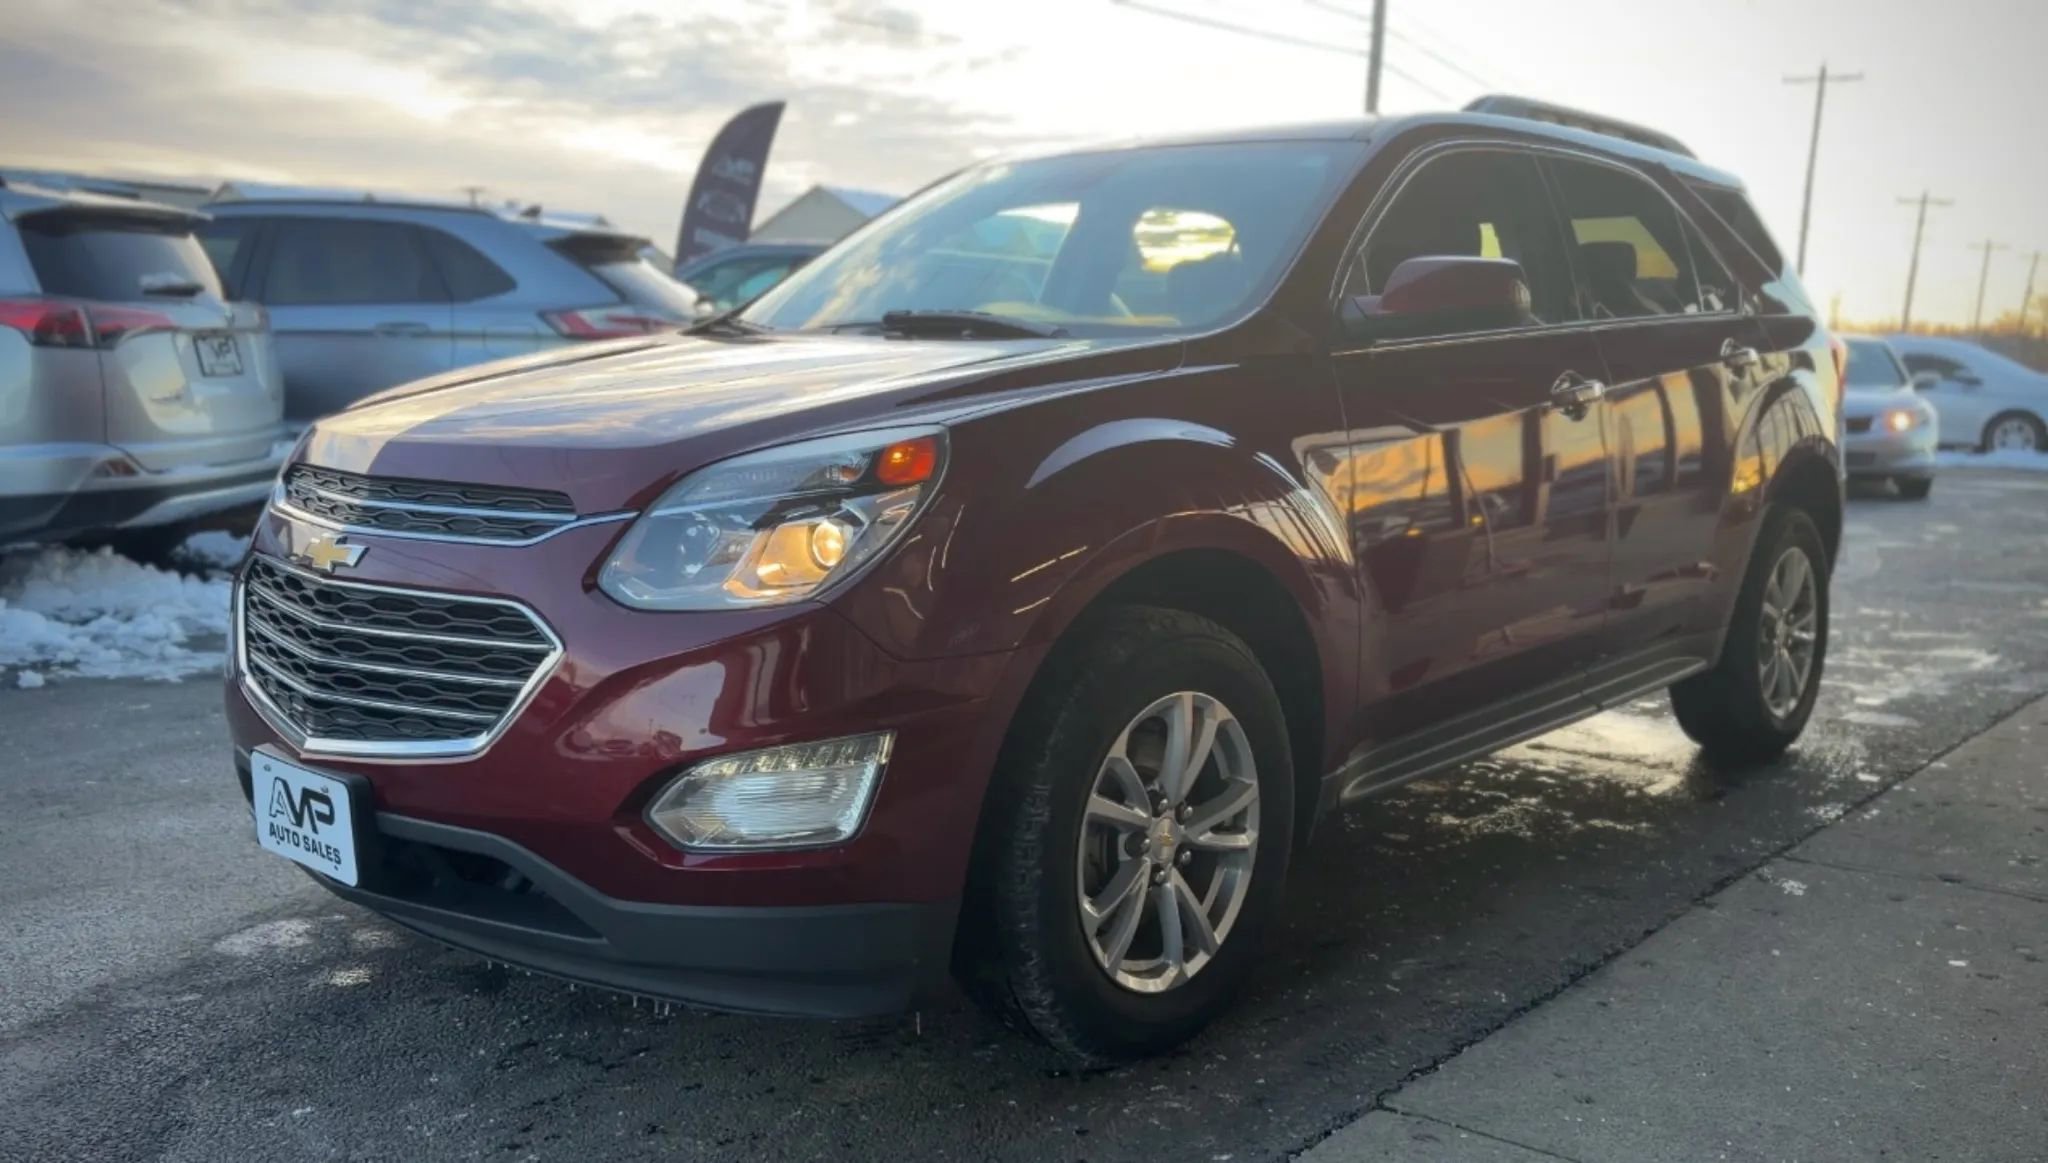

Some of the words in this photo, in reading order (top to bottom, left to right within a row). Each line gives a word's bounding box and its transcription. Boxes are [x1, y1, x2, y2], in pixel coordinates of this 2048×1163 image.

[269, 776, 335, 834] AVP
[269, 821, 300, 848] AUTO
[303, 834, 342, 865] SALES
